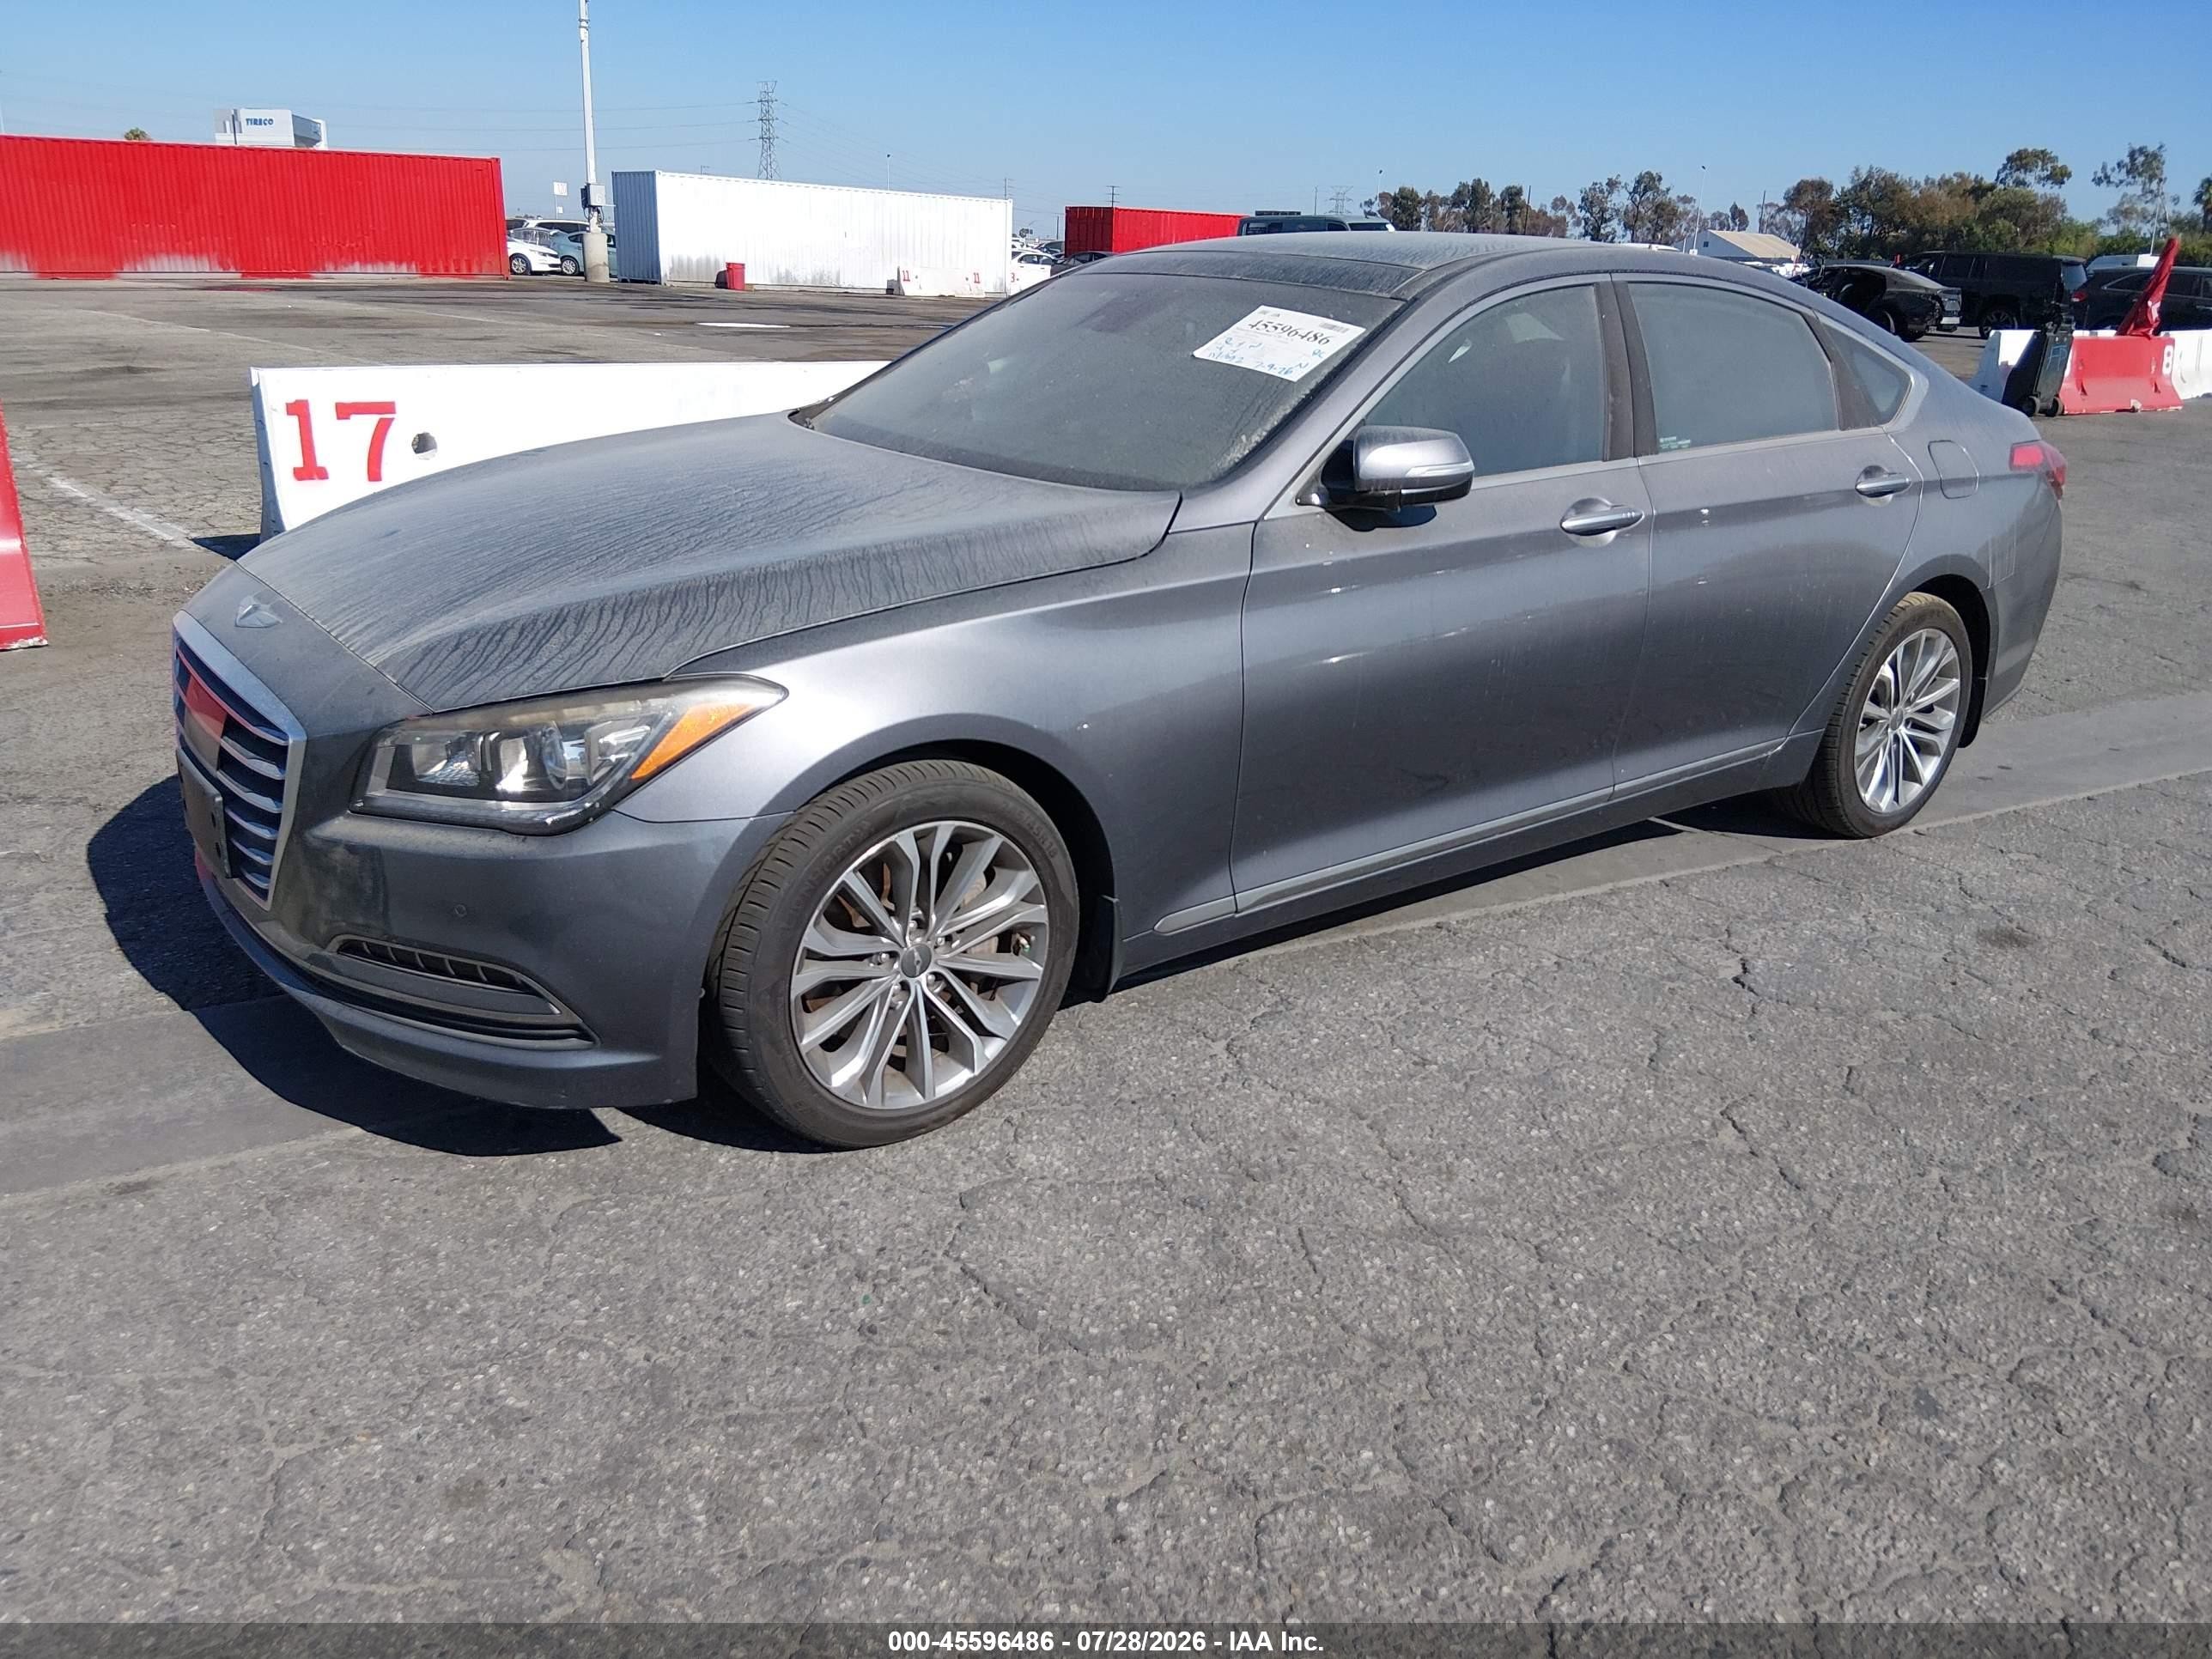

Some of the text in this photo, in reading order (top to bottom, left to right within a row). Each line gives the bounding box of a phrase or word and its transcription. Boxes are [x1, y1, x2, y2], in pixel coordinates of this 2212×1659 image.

[246, 118, 274, 126] TIRECO
[902, 270, 911, 282] 11
[973, 272, 981, 283] 11
[1248, 319, 1331, 345] 45596486
[285, 399, 396, 482] 17
